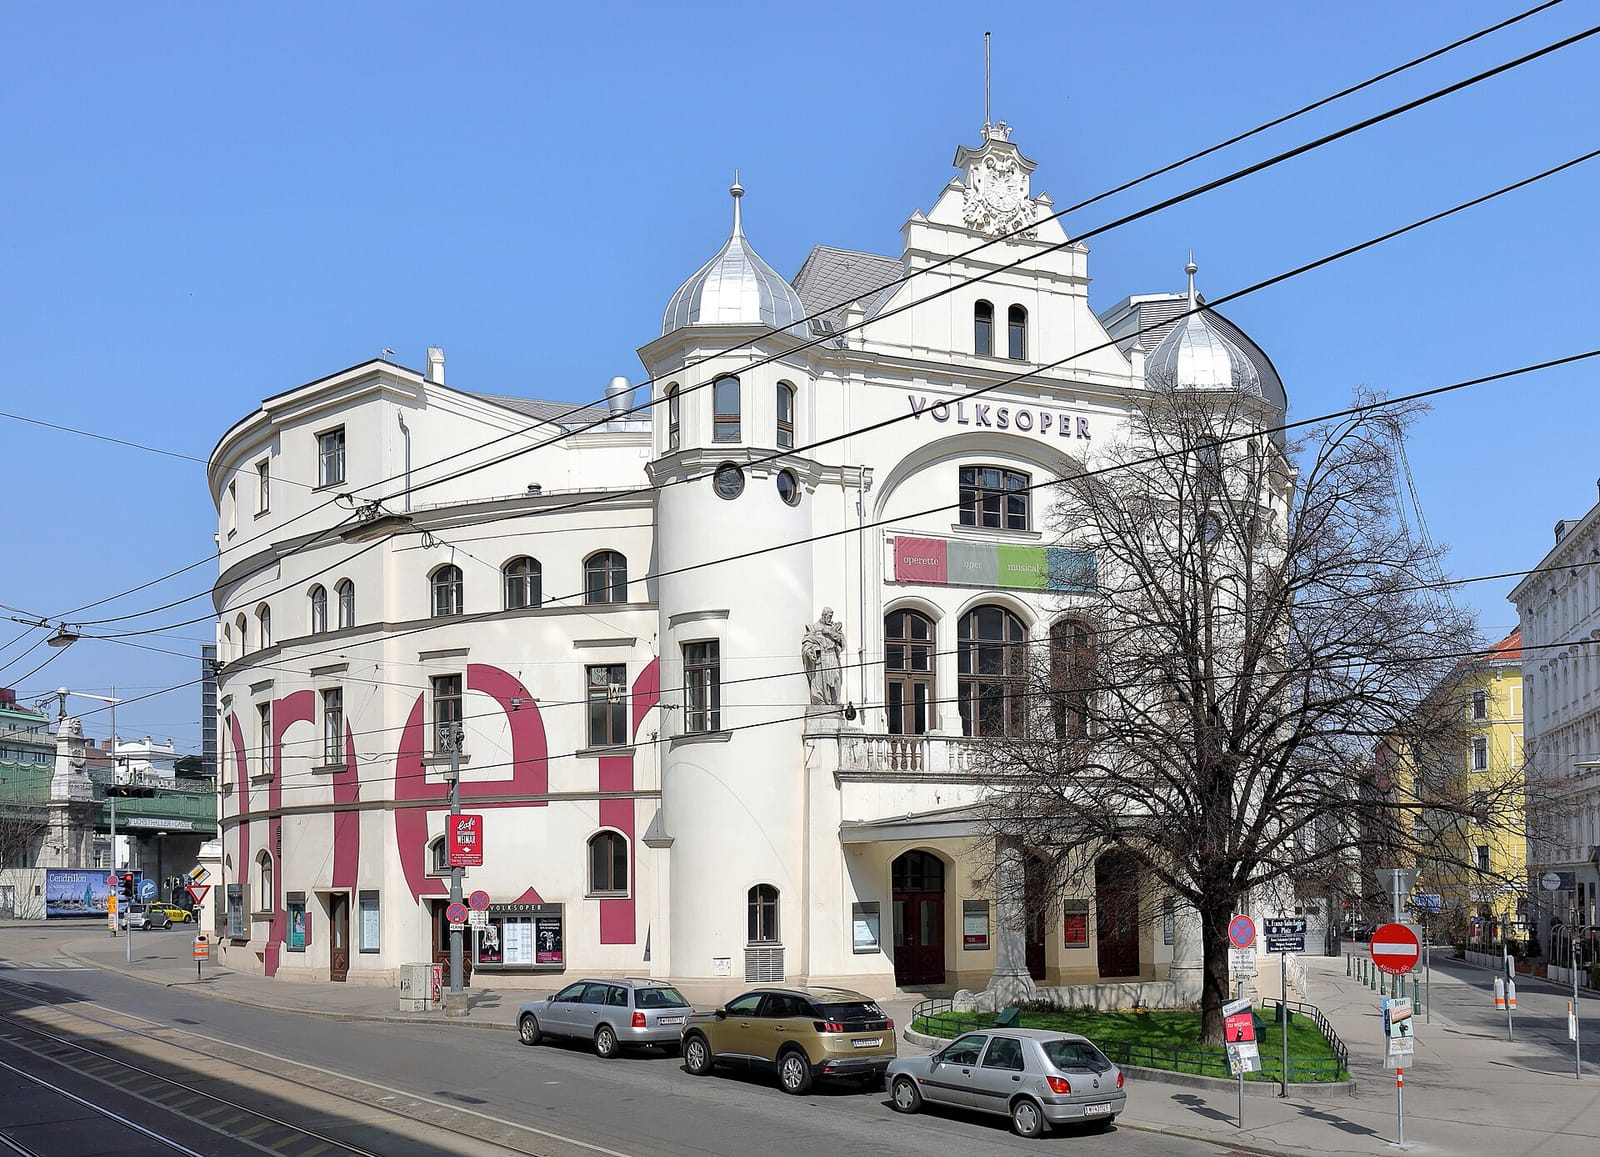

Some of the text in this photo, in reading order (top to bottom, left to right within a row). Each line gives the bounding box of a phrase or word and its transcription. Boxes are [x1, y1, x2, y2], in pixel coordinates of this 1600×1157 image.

[908, 395, 1091, 440] VOLKSOPER
[903, 555, 939, 566] operette
[963, 561, 983, 570] oper
[1007, 562, 1039, 572] musical
[50, 873, 87, 883] Cendrillon
